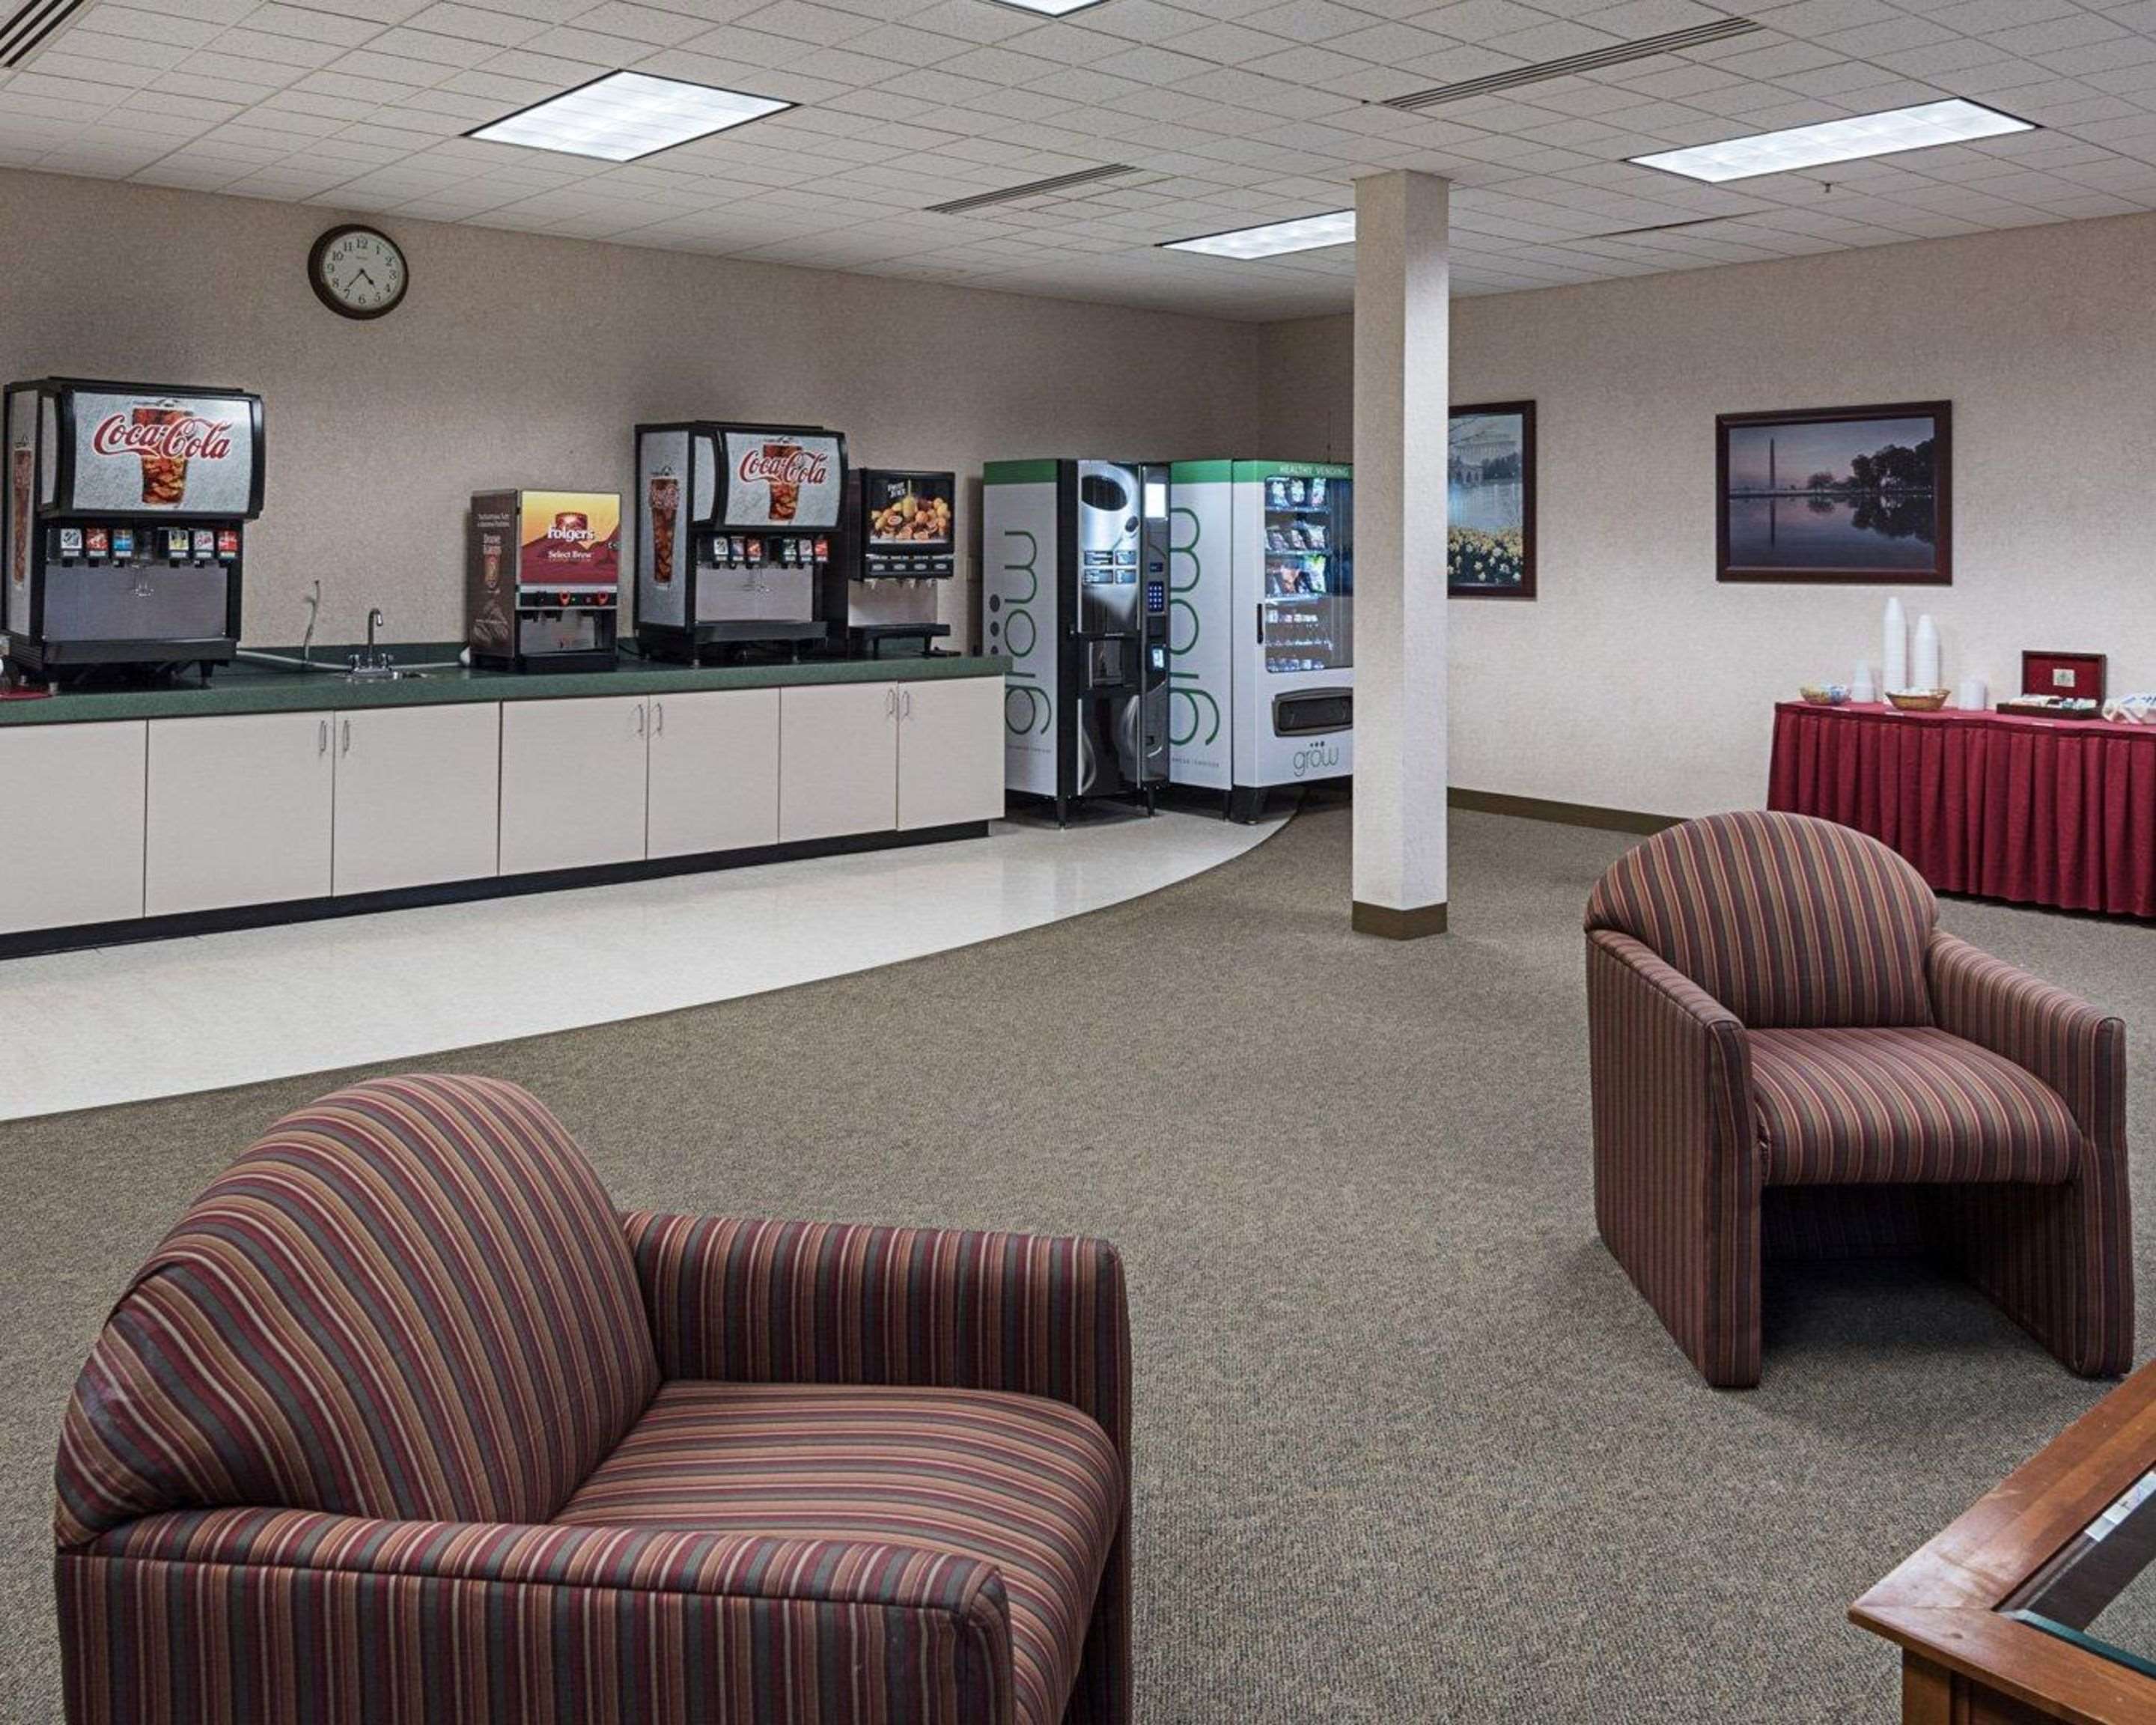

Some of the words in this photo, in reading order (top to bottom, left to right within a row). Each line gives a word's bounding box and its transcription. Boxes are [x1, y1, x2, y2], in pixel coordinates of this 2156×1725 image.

[93, 414, 234, 460] Coca-Cola
[738, 449, 829, 485] Coca-Cola
[547, 525, 594, 543] Folgers
[1294, 746, 1339, 777] grow
